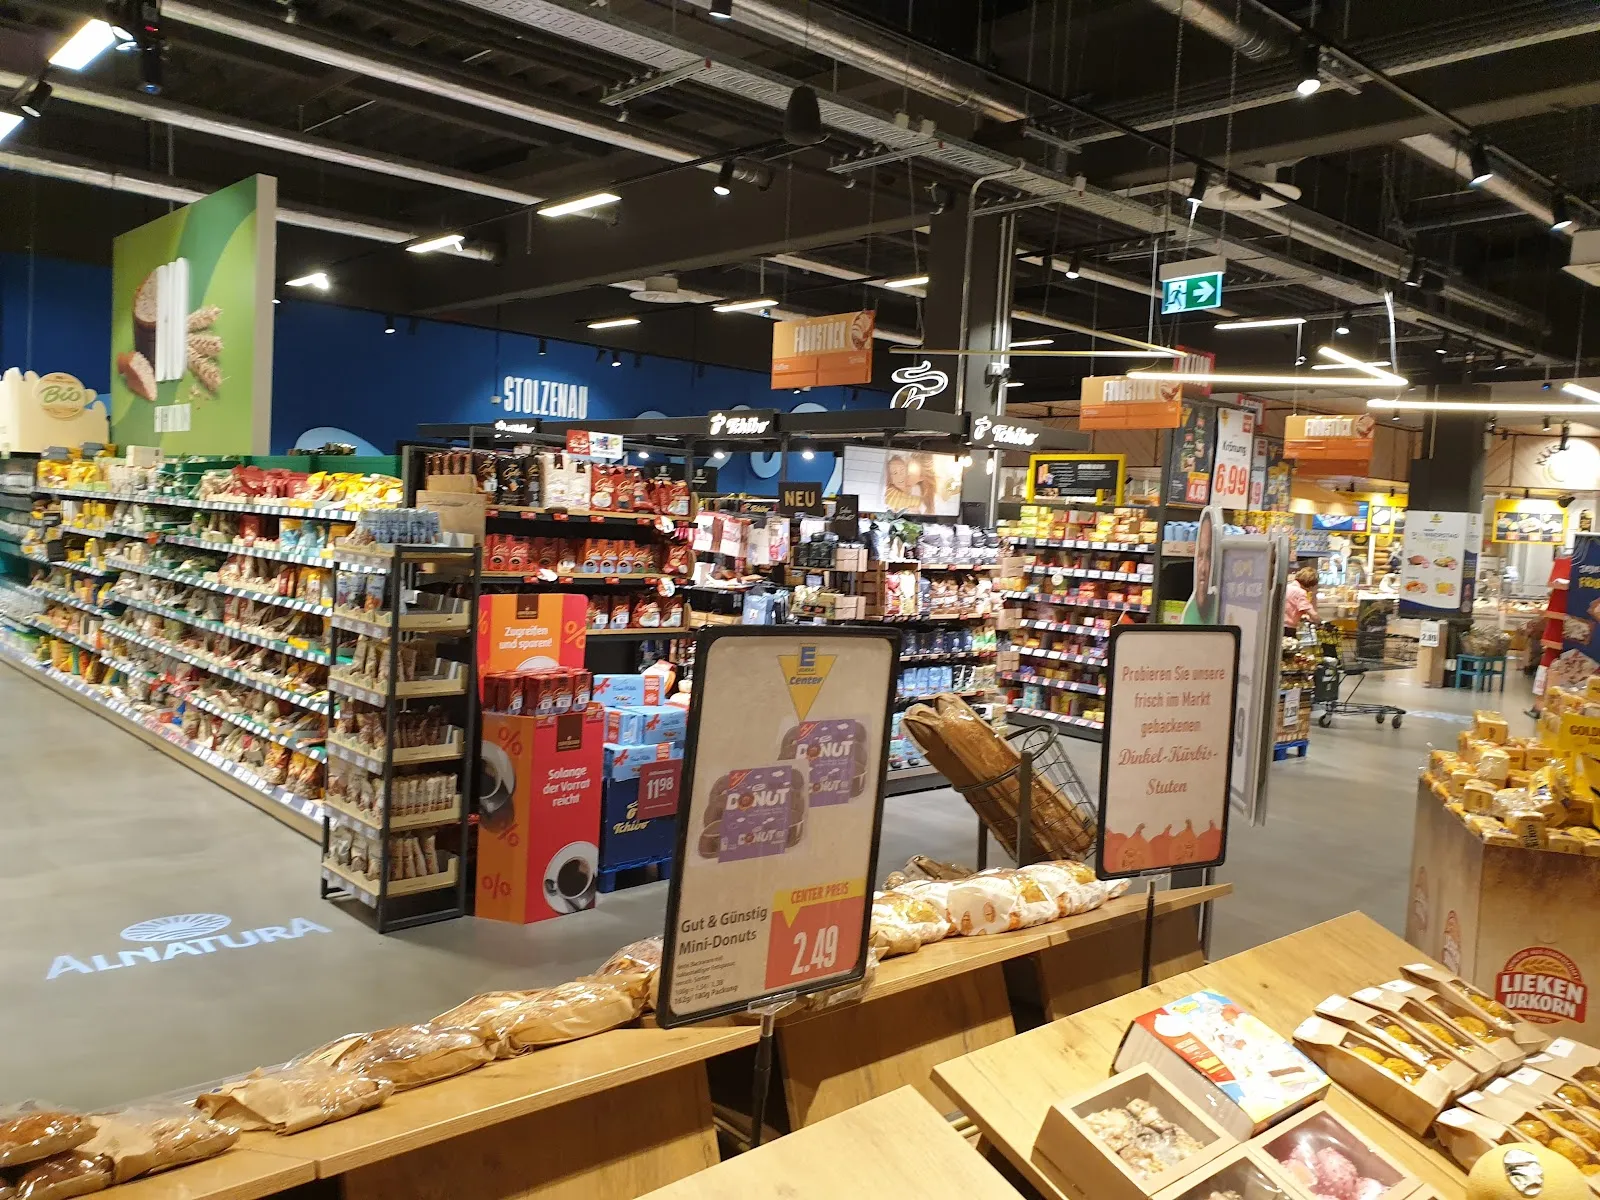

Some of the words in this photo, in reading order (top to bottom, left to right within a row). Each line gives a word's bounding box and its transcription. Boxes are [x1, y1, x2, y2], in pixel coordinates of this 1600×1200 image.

[40, 385, 82, 404] Bio
[503, 376, 589, 420] STOLZENAU
[784, 490, 816, 508] NEU
[504, 626, 548, 638] Zugreifen
[499, 638, 517, 649] und
[518, 637, 552, 650] sparen!
[789, 676, 824, 685] Center
[1122, 665, 1172, 681] Probieren
[1174, 665, 1191, 681] Sie
[1192, 668, 1226, 681] unsere
[1134, 692, 1163, 708] frisch
[1166, 691, 1180, 707] im
[1181, 691, 1212, 707] Markt
[1140, 718, 1203, 738] gebackenen
[1118, 744, 1219, 766] Dinkel-Kürbis-
[548, 765, 588, 780] Solange
[542, 783, 560, 795] der
[561, 779, 591, 792] Vorrat
[1145, 778, 1188, 796] Stuten
[552, 793, 581, 807] reicht
[612, 819, 650, 835] Tchibo
[790, 886, 823, 904] CENTER
[825, 881, 849, 896] PREIS
[681, 918, 704, 934] Gut
[707, 915, 718, 929] &
[720, 905, 768, 926] Günstig
[46, 916, 333, 981] ALNATURA
[678, 928, 757, 956] Mini-Donuts
[790, 924, 839, 976] 2.49
[1500, 973, 1585, 1005] LIEKEN
[1505, 992, 1577, 1018] URKORN
